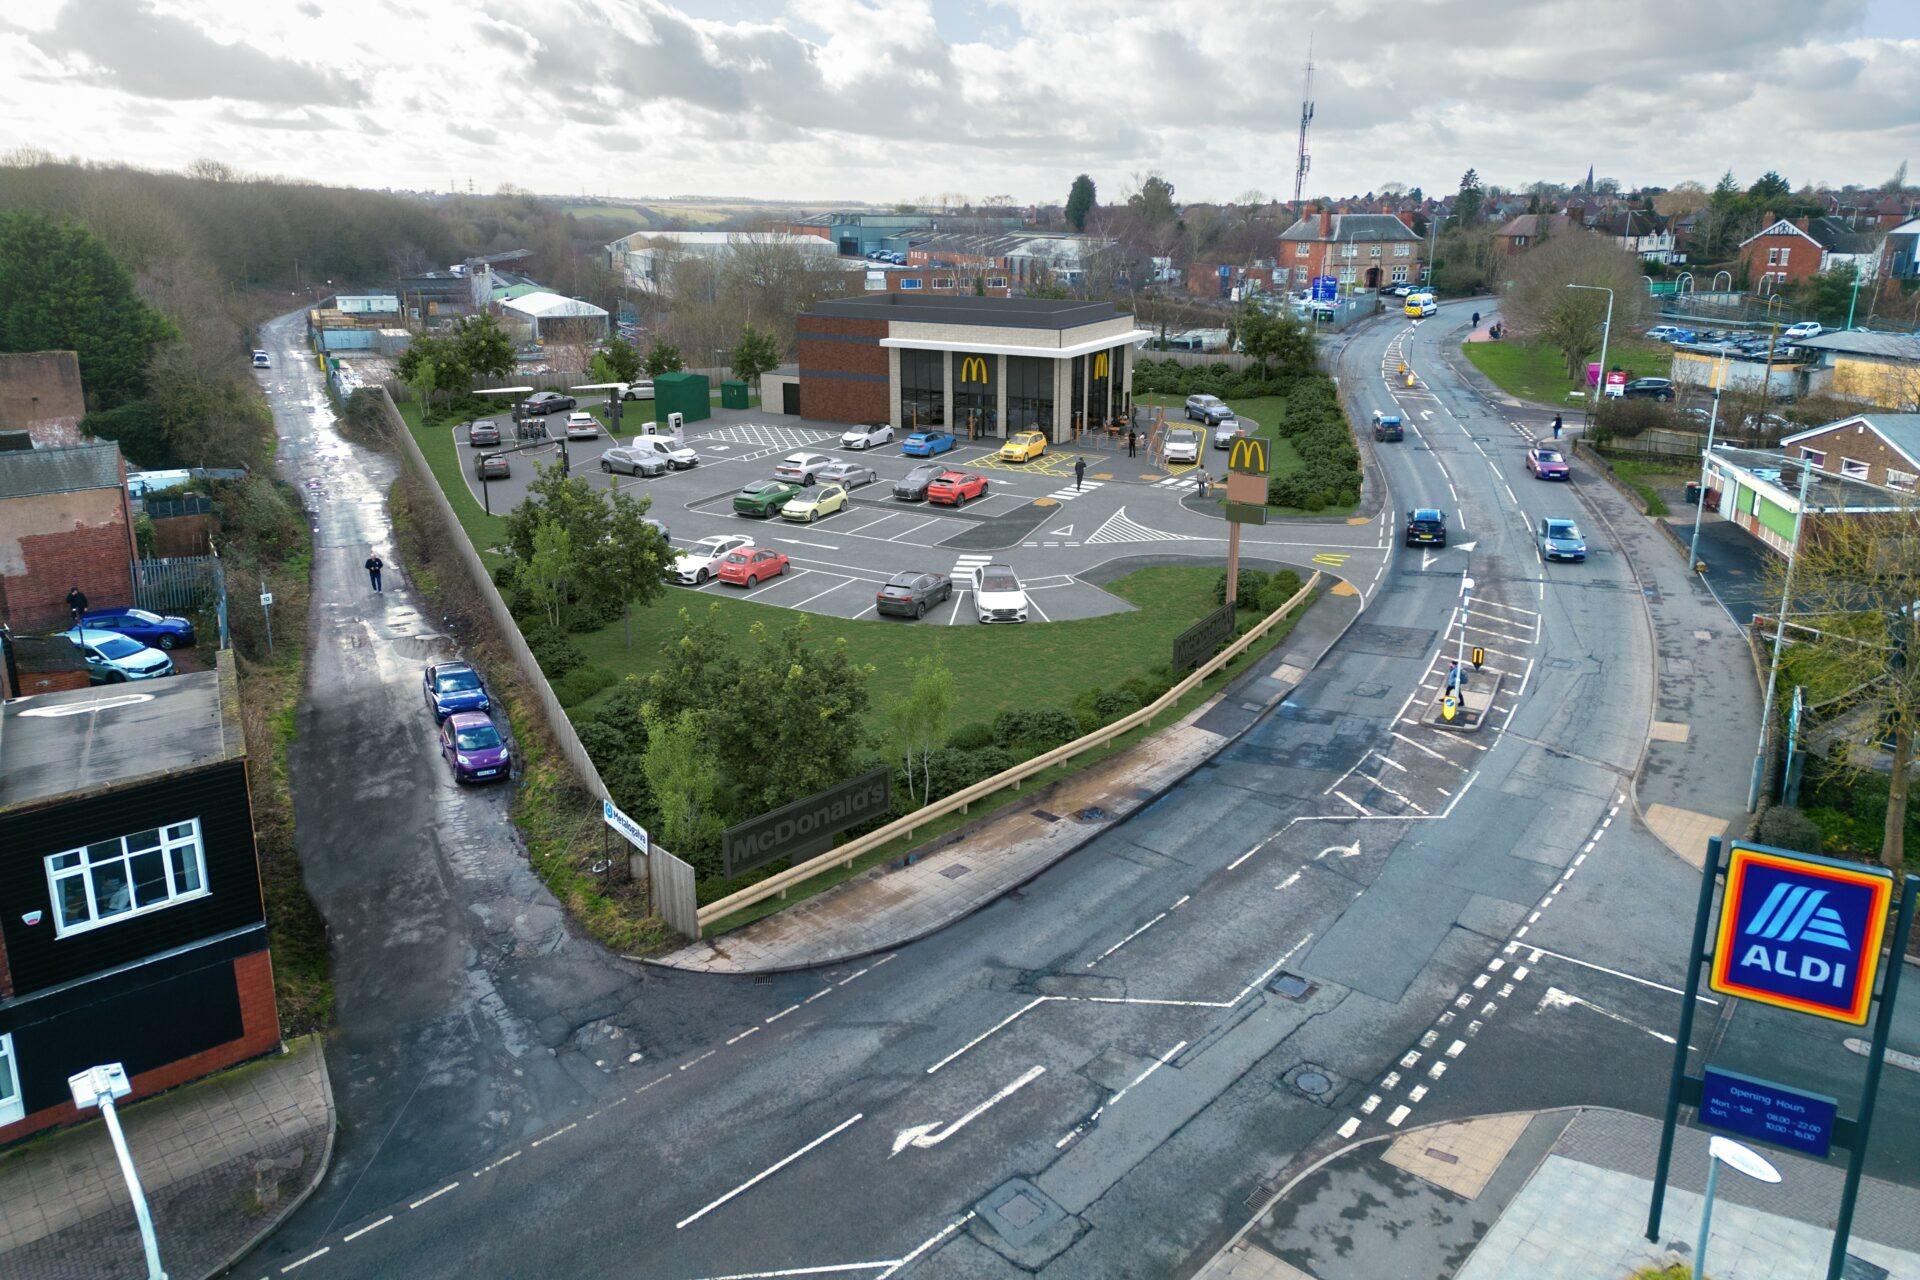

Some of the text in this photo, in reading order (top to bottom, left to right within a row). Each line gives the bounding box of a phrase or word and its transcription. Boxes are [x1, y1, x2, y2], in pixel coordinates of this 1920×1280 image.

[732, 783, 885, 864] McDonald's
[1740, 944, 1846, 988] ALDI
[1730, 1087, 1805, 1113] Opening Hours
